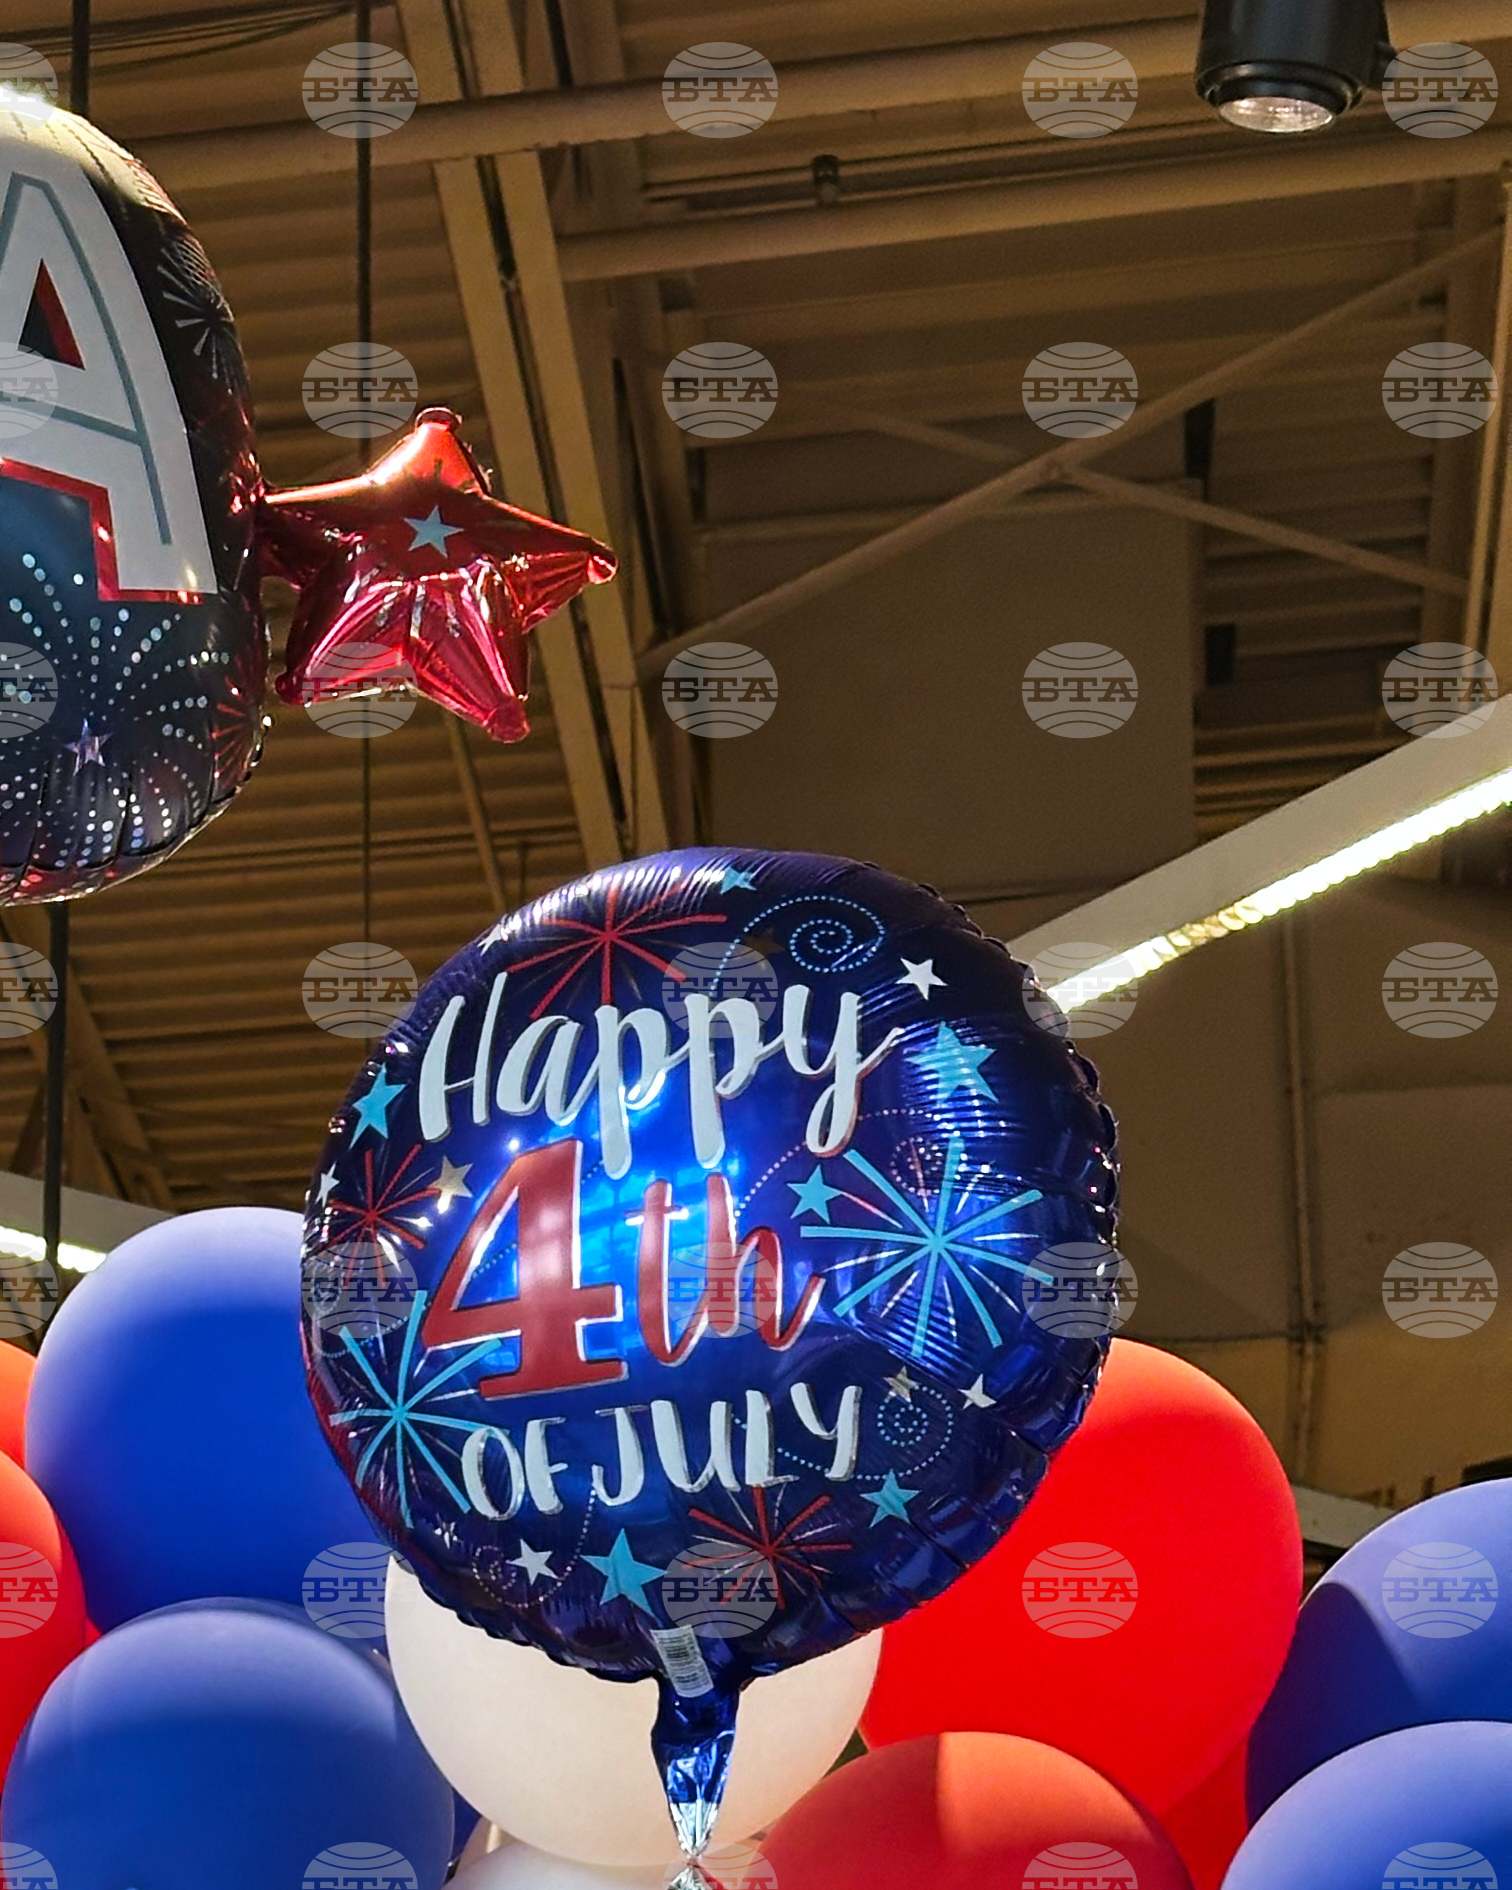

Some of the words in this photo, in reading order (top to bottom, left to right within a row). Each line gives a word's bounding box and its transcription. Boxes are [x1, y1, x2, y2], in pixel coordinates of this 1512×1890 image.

[419, 972, 901, 1180] Happy
[421, 1139, 823, 1400] 4th
[461, 1416, 568, 1523] OF
[592, 1383, 864, 1507] JULY
